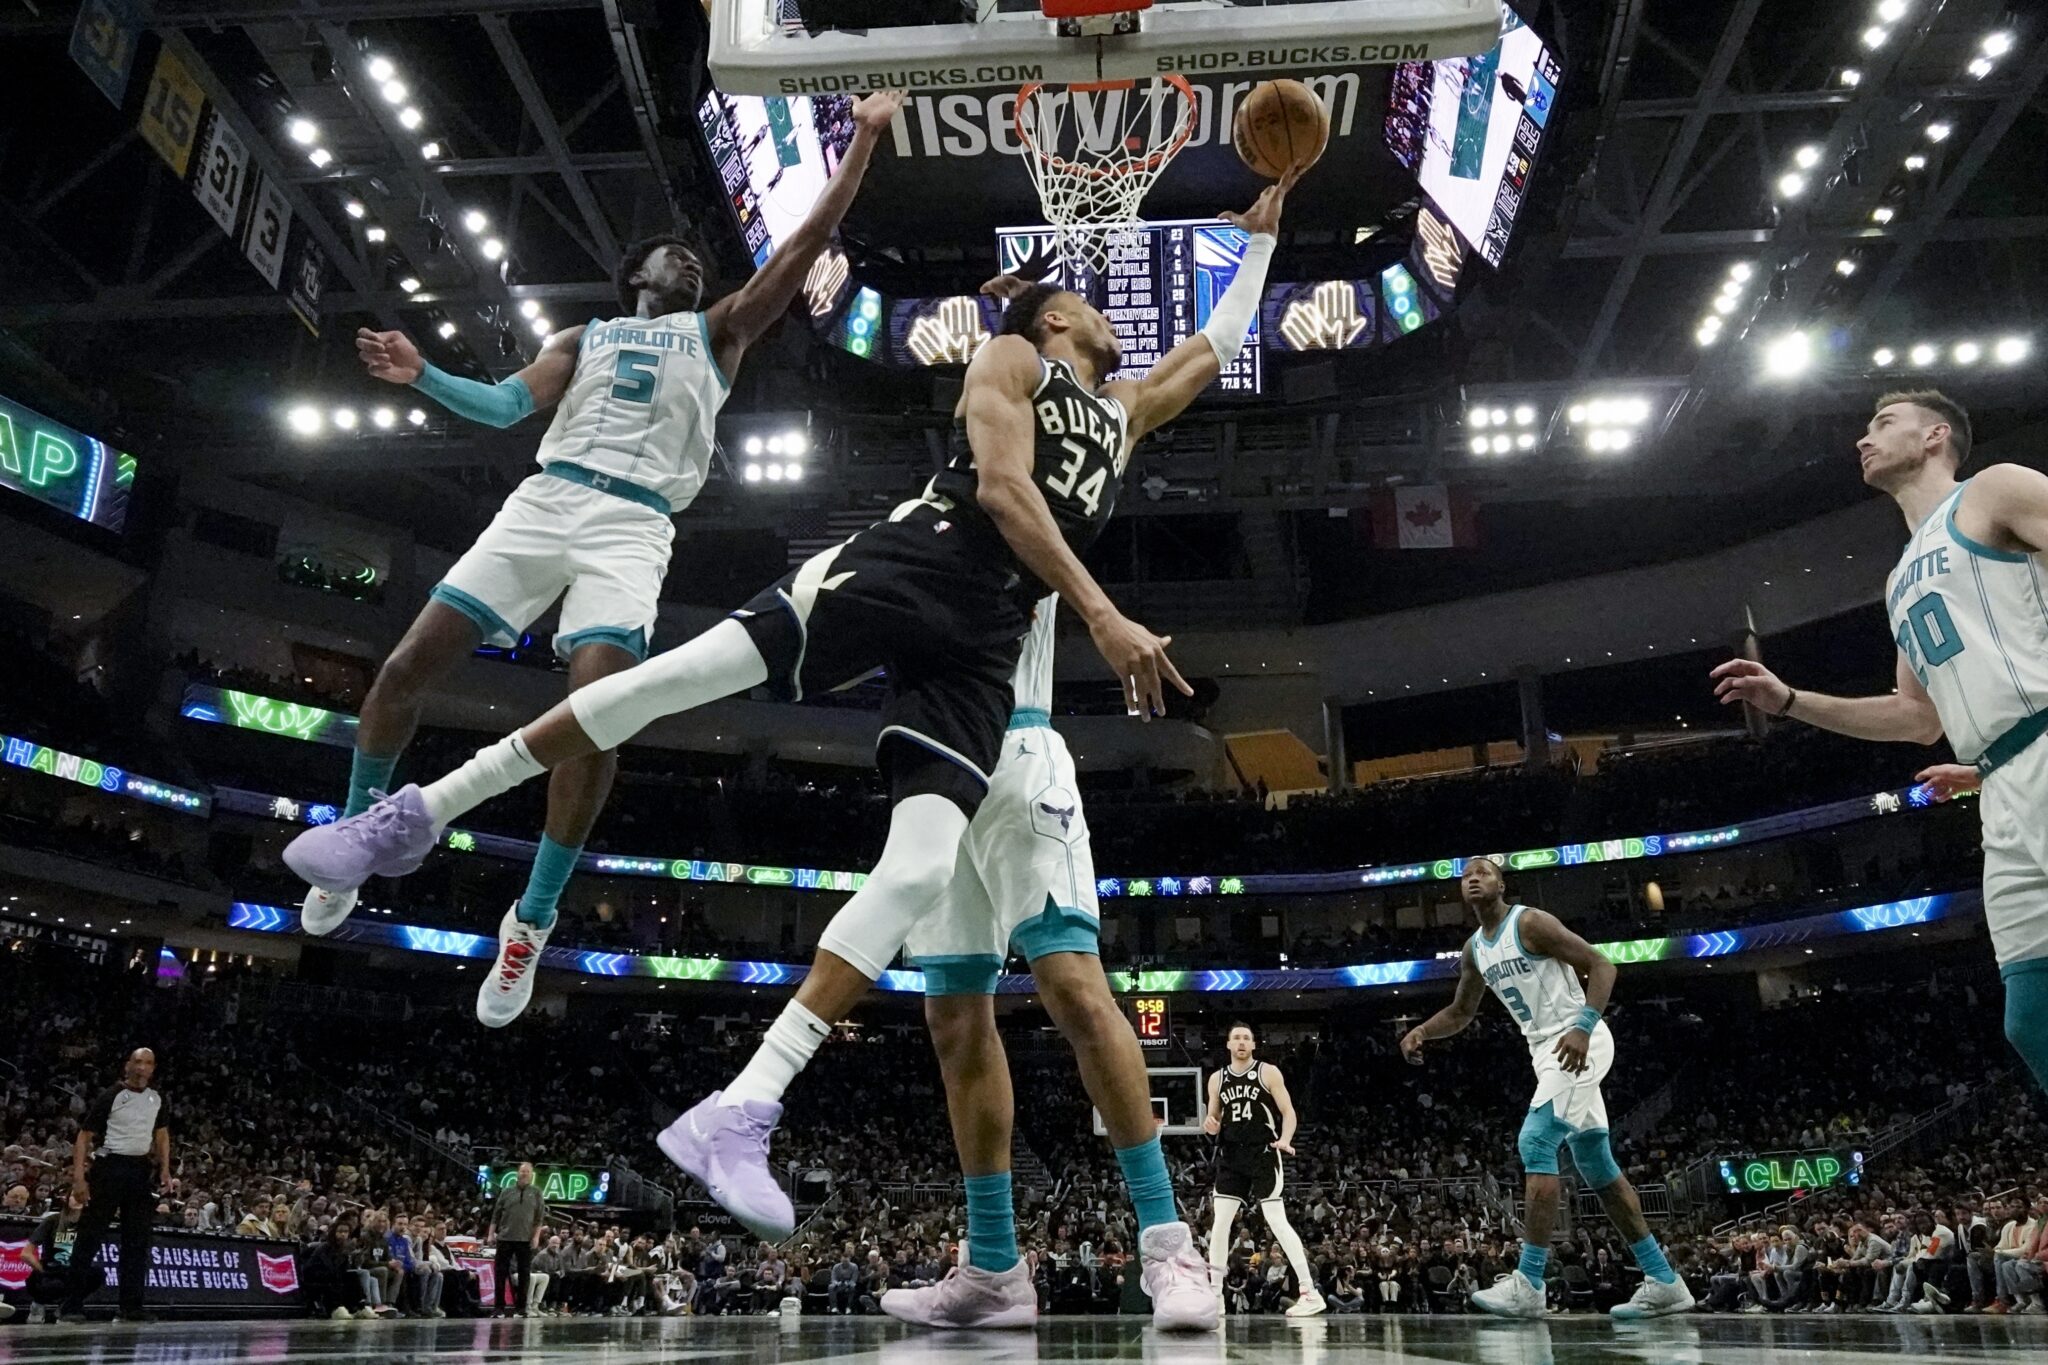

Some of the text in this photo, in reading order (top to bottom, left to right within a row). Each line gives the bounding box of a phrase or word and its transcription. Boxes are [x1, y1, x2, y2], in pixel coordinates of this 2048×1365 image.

[1156, 43, 1429, 72] SHOP.BUCKS.COM
[779, 64, 1043, 94] SHOP.BUCKS.COM
[151, 77, 194, 147] 15
[889, 72, 1361, 157] fiserv.form
[209, 144, 240, 207] 31
[260, 207, 281, 256] 3
[1171, 228, 1184, 241] 23
[1174, 244, 1181, 256] 4
[1108, 262, 1150, 276] STEALS
[1174, 259, 1182, 271] 5
[1074, 278, 1087, 290] 14
[1107, 278, 1152, 291] OFF REB
[1172, 273, 1185, 286] 16
[1108, 292, 1152, 306] DEF REB
[1173, 319, 1186, 331] 15
[588, 327, 698, 360] CHARLOTTE
[1138, 337, 1158, 350] PTS
[1130, 352, 1162, 365] GOALS
[611, 350, 660, 404] 5
[1036, 396, 1123, 479] BUCKS
[1046, 436, 1108, 518] 34
[6, 737, 122, 792] HANDS
[1562, 835, 1662, 865] HANDS
[671, 859, 743, 883] CLAP
[797, 868, 869, 892] HAND
[1136, 999, 1165, 1014] 9:58
[1501, 986, 1533, 1023] 3
[1141, 1013, 1161, 1036] 12
[1138, 1038, 1169, 1046] TISSOT
[1220, 1084, 1261, 1105] BUCKS
[1231, 1101, 1253, 1122] 24
[1745, 1157, 1840, 1192] CLAP
[698, 1212, 732, 1225] clover
[152, 1246, 240, 1269] SAUSAGE OF
[202, 1271, 249, 1290] BUCKS
